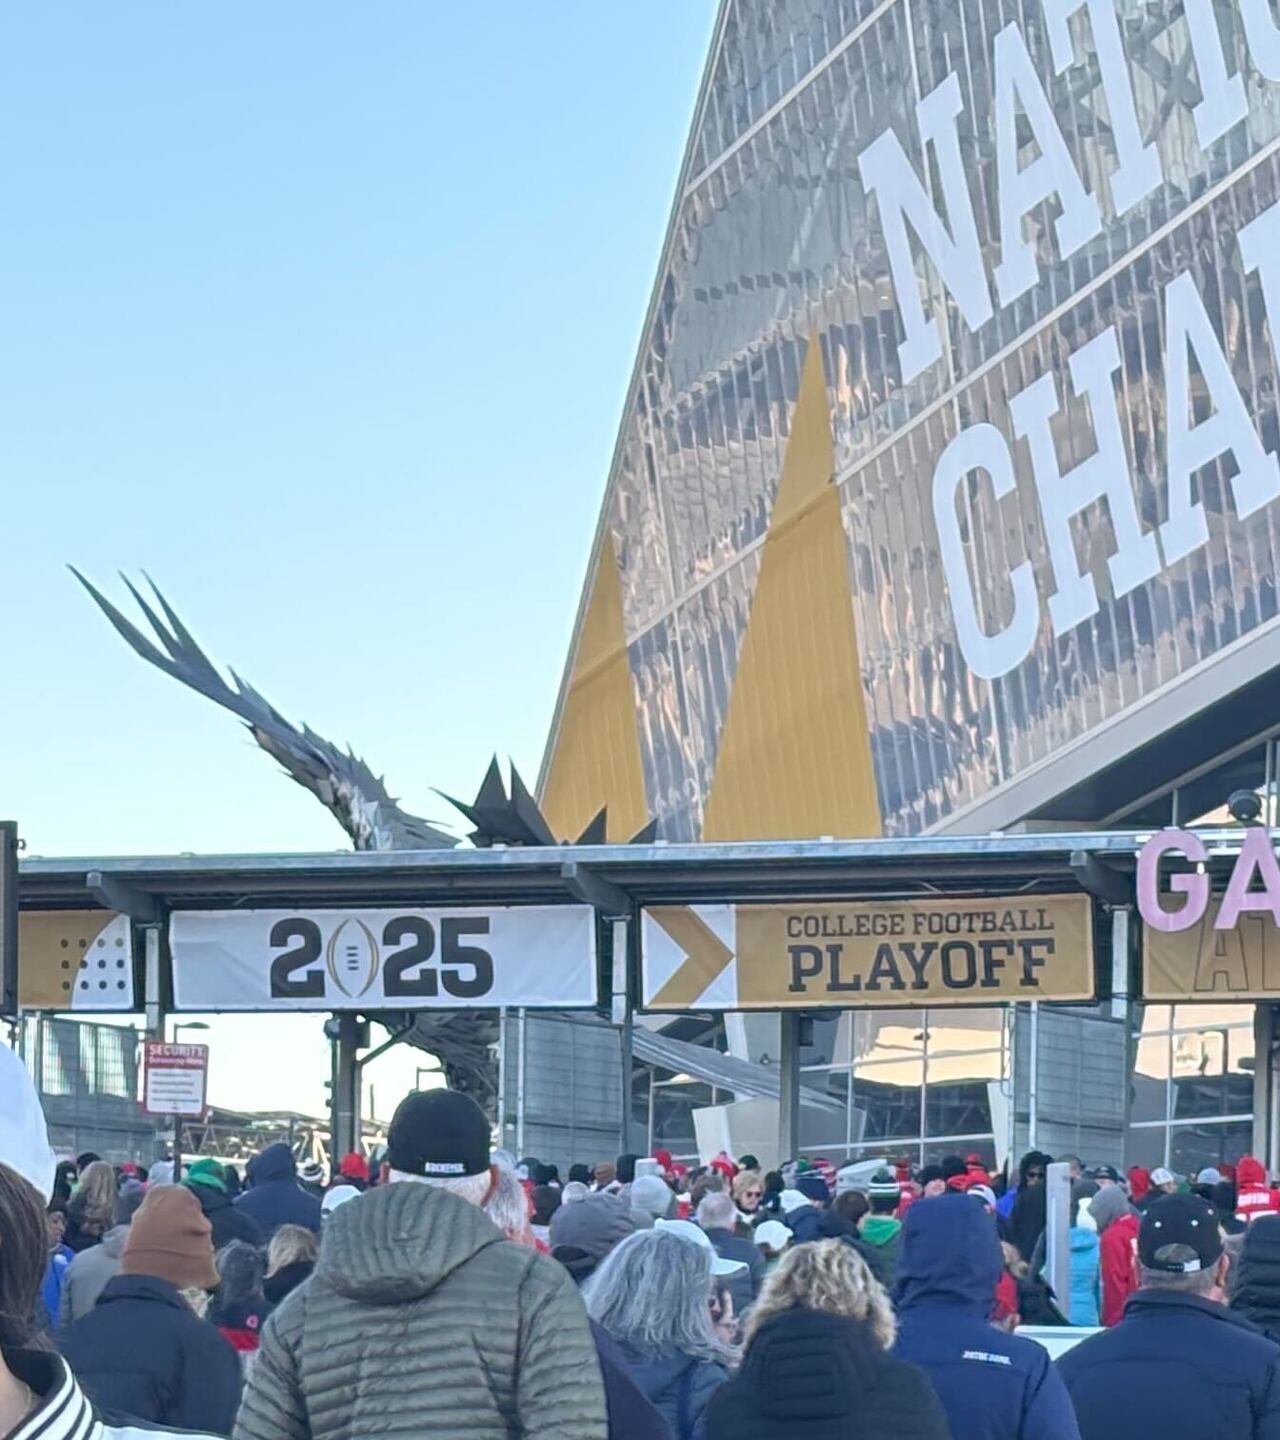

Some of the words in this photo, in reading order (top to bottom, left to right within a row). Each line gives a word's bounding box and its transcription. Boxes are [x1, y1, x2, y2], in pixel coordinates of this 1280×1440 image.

[786, 913, 905, 939] COLLEGE
[912, 908, 1055, 935] FOOTBALL
[787, 937, 1056, 993] PLAYOFF
